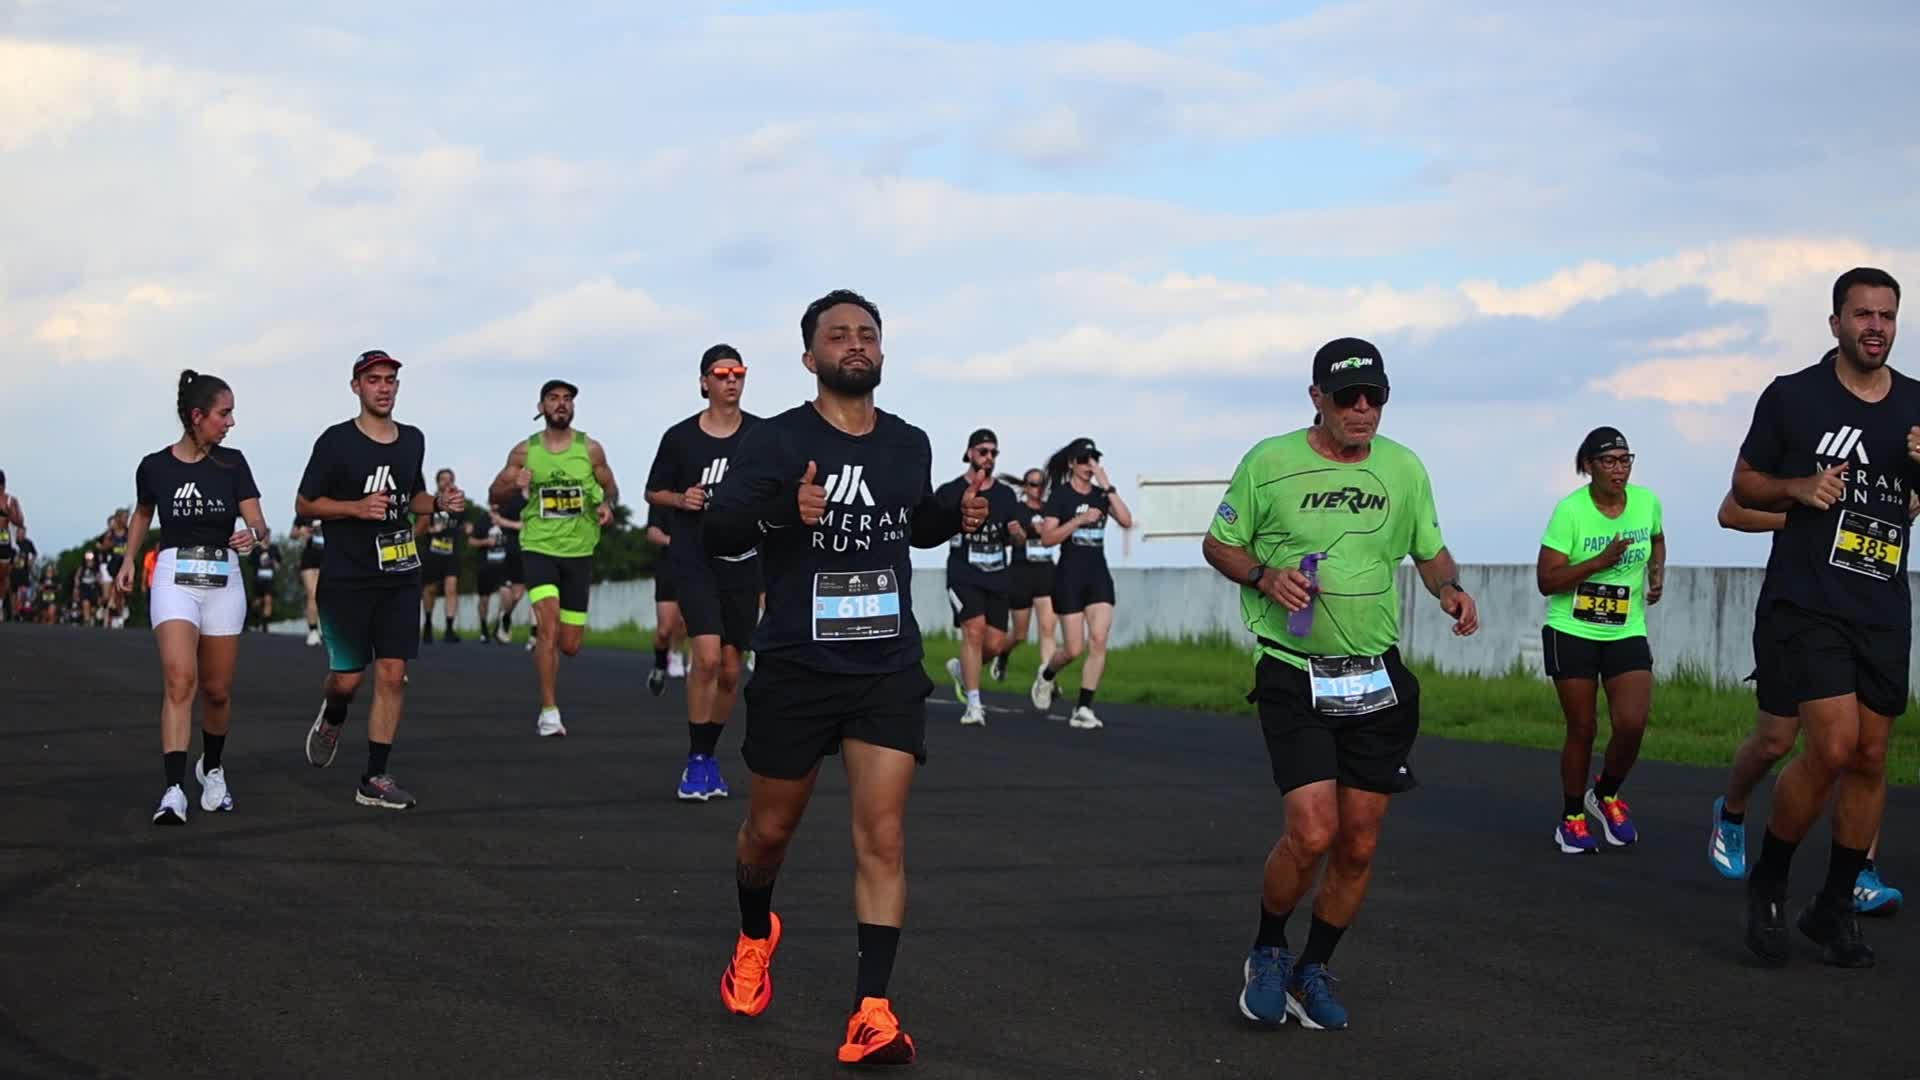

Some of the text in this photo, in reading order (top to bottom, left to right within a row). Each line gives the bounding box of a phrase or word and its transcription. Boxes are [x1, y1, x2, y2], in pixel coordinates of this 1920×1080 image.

[1330, 356, 1373, 373] IVERUN
[1816, 462, 1903, 492] MERAK
[172, 499, 224, 508] MERAK
[1300, 486, 1386, 514] IVERUN
[1838, 486, 1868, 505] UN
[172, 507, 204, 517] RUN
[818, 506, 910, 532] MERAK
[812, 531, 871, 552] RUN
[1852, 535, 1888, 561] 385
[187, 560, 217, 574] 786
[837, 595, 881, 618] 618
[1588, 596, 1618, 613] 343
